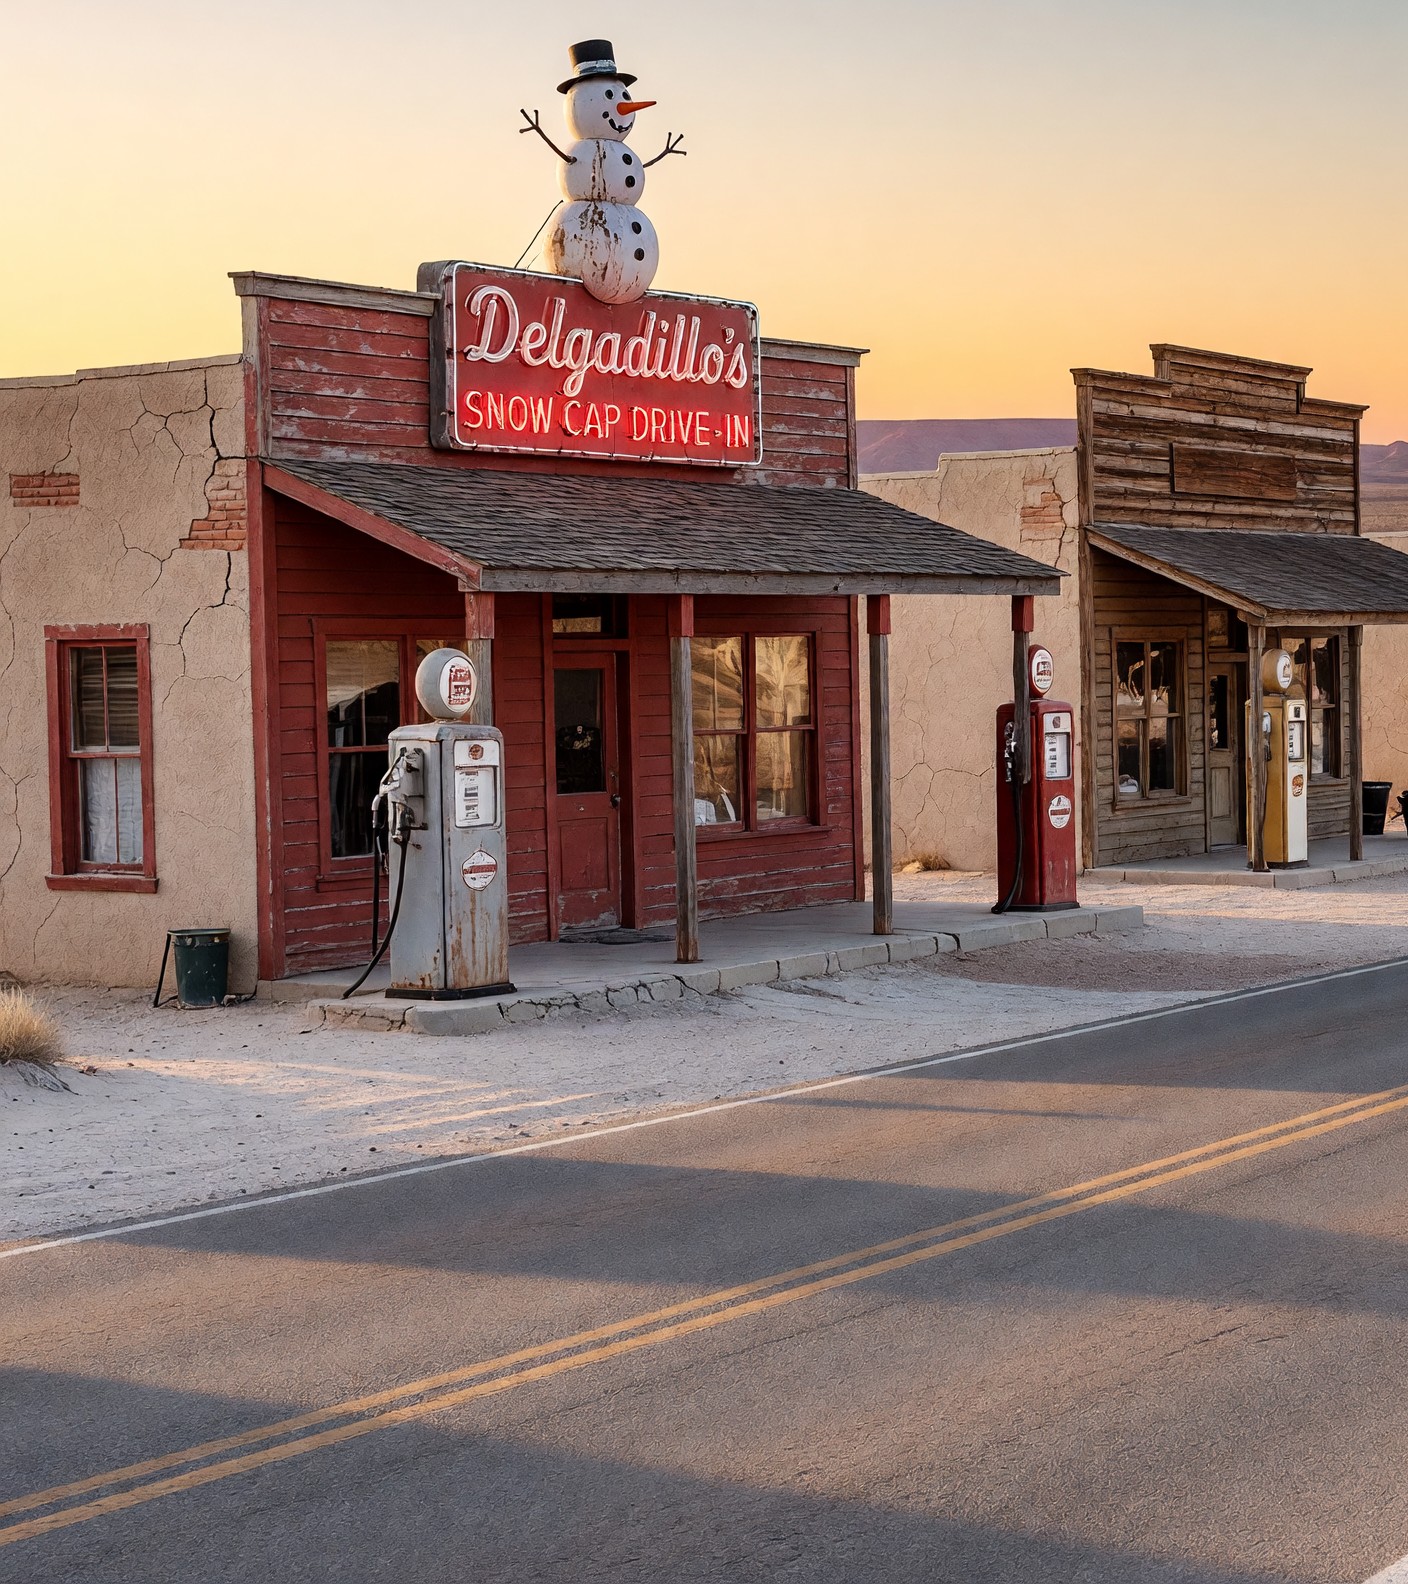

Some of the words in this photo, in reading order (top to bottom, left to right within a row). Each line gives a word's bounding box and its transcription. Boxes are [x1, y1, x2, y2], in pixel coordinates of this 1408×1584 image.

[464, 284, 748, 397] Delgadillo's
[464, 390, 553, 434] SNOW
[563, 400, 621, 438] CAP
[631, 405, 749, 448] DRIVE-IN
